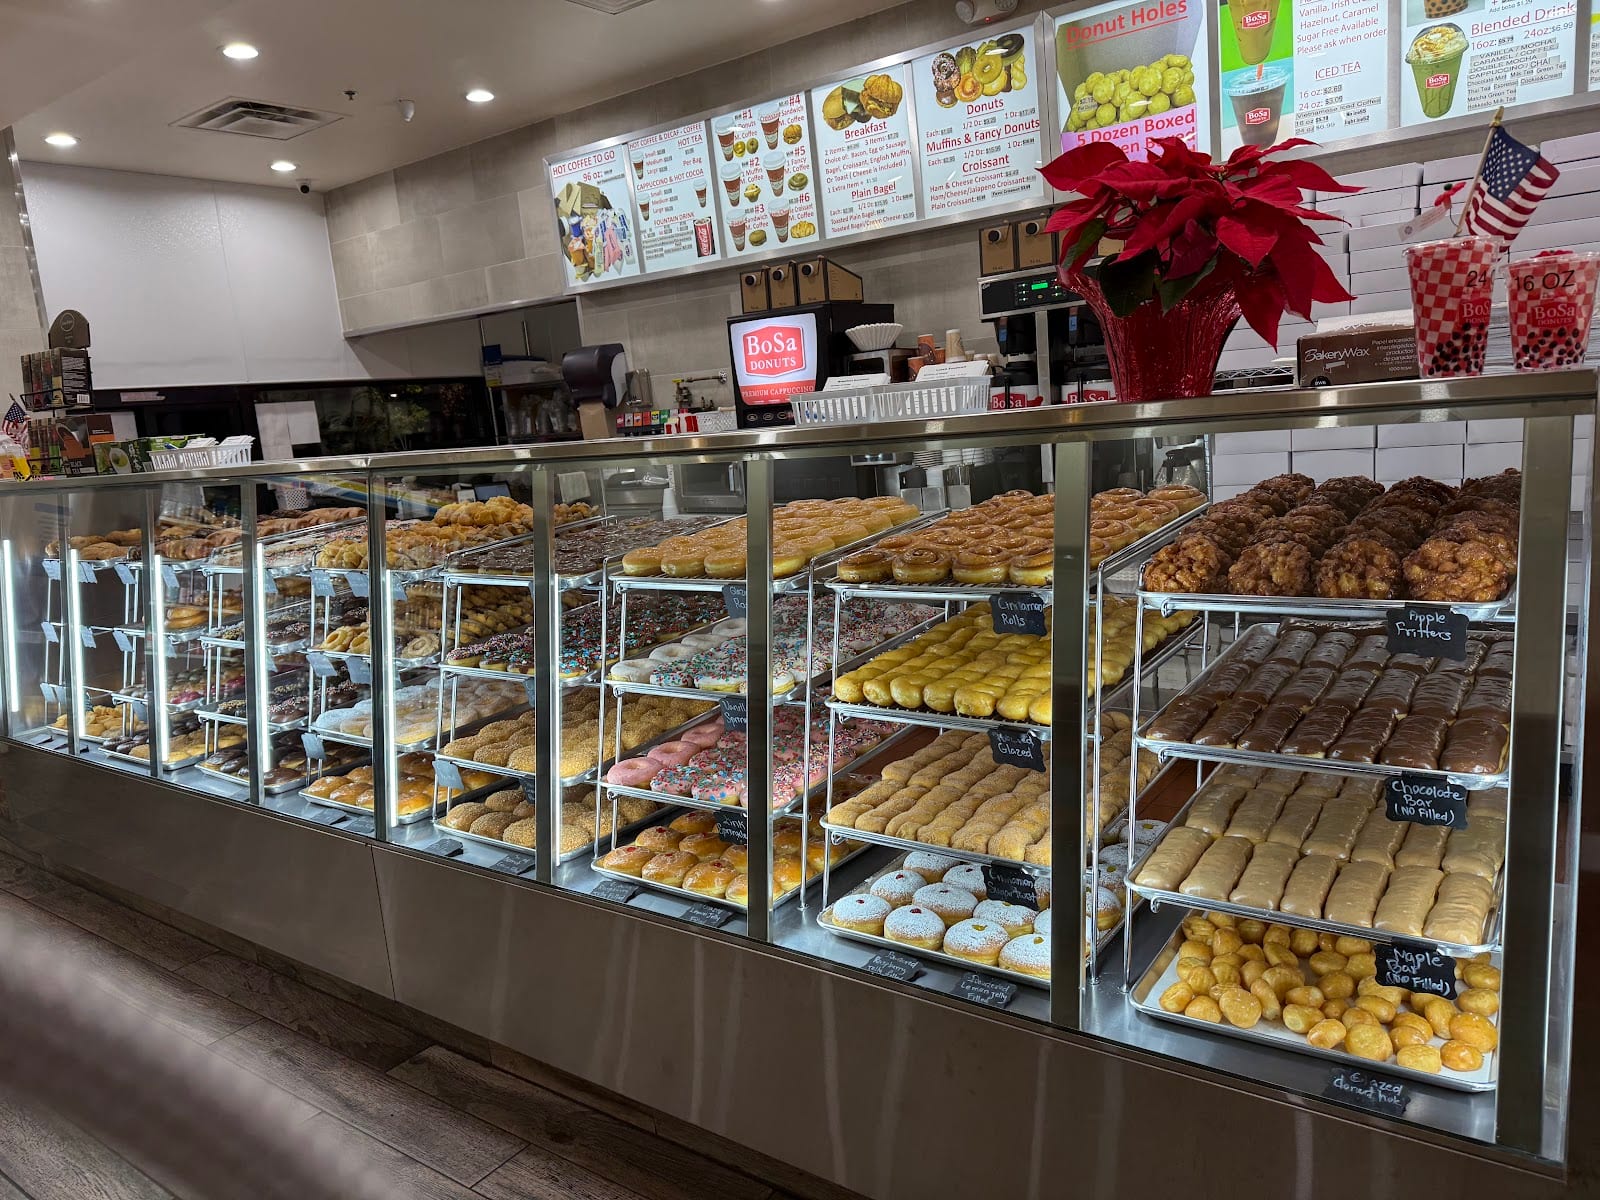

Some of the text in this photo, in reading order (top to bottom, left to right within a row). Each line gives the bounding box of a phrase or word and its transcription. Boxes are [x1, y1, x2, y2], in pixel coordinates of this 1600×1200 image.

[1300, 3, 1329, 17] Vanilla,
[1331, 0, 1349, 9] Irish
[1342, 2, 1378, 18] Caramel
[1067, 0, 1187, 44] Donut Holes
[1246, 14, 1266, 23] BoSa
[1471, 11, 1529, 35] Blended
[1297, 17, 1378, 44] Sugar Free Available
[1297, 28, 1386, 54] Please ask when order
[1472, 37, 1496, 50] 16oz:
[1479, 38, 1553, 58] VANILLA MOCHA
[1473, 53, 1512, 66] CARAMEL
[1506, 54, 1536, 65] MOCHA
[1530, 57, 1550, 67] CHAI
[1315, 60, 1360, 79] ICED TEA
[789, 95, 800, 106] #4
[1300, 90, 1308, 98] 16
[966, 96, 1003, 114] Donuts
[1299, 102, 1308, 110] 24
[742, 109, 752, 120] #1
[787, 114, 804, 124] Coffee
[1249, 110, 1267, 119] BoSa
[844, 119, 887, 139] Breakfast
[962, 121, 972, 129] 1/2
[1077, 109, 1195, 146] 5 Dozen Boxed
[629, 140, 639, 149] HOT
[640, 135, 657, 146] COFFEE
[683, 122, 701, 133] COFFEE
[677, 133, 702, 147] HOT TEA
[741, 129, 757, 138] Coffee
[869, 134, 886, 144] Items:
[926, 117, 1039, 152] Muffins & Fancy Donuts
[793, 145, 805, 156] #5
[824, 155, 840, 164] Choice
[868, 146, 877, 154] Egg
[885, 138, 906, 150] Sausage
[869, 147, 910, 164] English Muffin,
[964, 150, 974, 159] 1/2
[552, 150, 614, 175] HOT COFFEE TO GO
[749, 156, 759, 167] #2
[792, 162, 809, 172] Coffee
[962, 153, 1009, 172] Croissant
[745, 166, 762, 175] Muffin
[835, 173, 848, 181] Toast
[852, 167, 872, 177] Cheese
[878, 159, 902, 171] included
[636, 177, 668, 190] CAPPUCCINO
[685, 168, 703, 178] COCOA
[747, 173, 763, 182] Coffee
[930, 183, 943, 191] Ham
[951, 178, 972, 187] Cheese
[851, 181, 895, 199] Plain Bagel
[799, 192, 809, 203] #6
[754, 203, 764, 214] #3
[931, 202, 945, 210] Plain
[796, 210, 813, 219] Coffee
[752, 220, 768, 229] Coffee
[1466, 271, 1487, 287] 24
[1516, 270, 1575, 291] 16 OZ
[1463, 301, 1491, 318] BoS
[1534, 304, 1575, 320] BoSa
[1538, 317, 1572, 325] DONUTS
[746, 332, 797, 355] BoSa
[1305, 347, 1370, 362] BakeryWax
[750, 357, 796, 371] DONUTS
[770, 386, 814, 395] CAPPUCCINO
[1001, 613, 1025, 626] Rolls
[1410, 610, 1445, 627] Apple
[1395, 621, 1451, 640] Fritters
[998, 743, 1033, 758] Glazed
[1392, 780, 1465, 800] Chocolate
[1403, 794, 1432, 807] Bar
[1419, 809, 1454, 825] Filled)
[1393, 948, 1444, 969] Maple
[1386, 960, 1417, 974] Bar
[961, 982, 1007, 1003] Lemon Jelly
